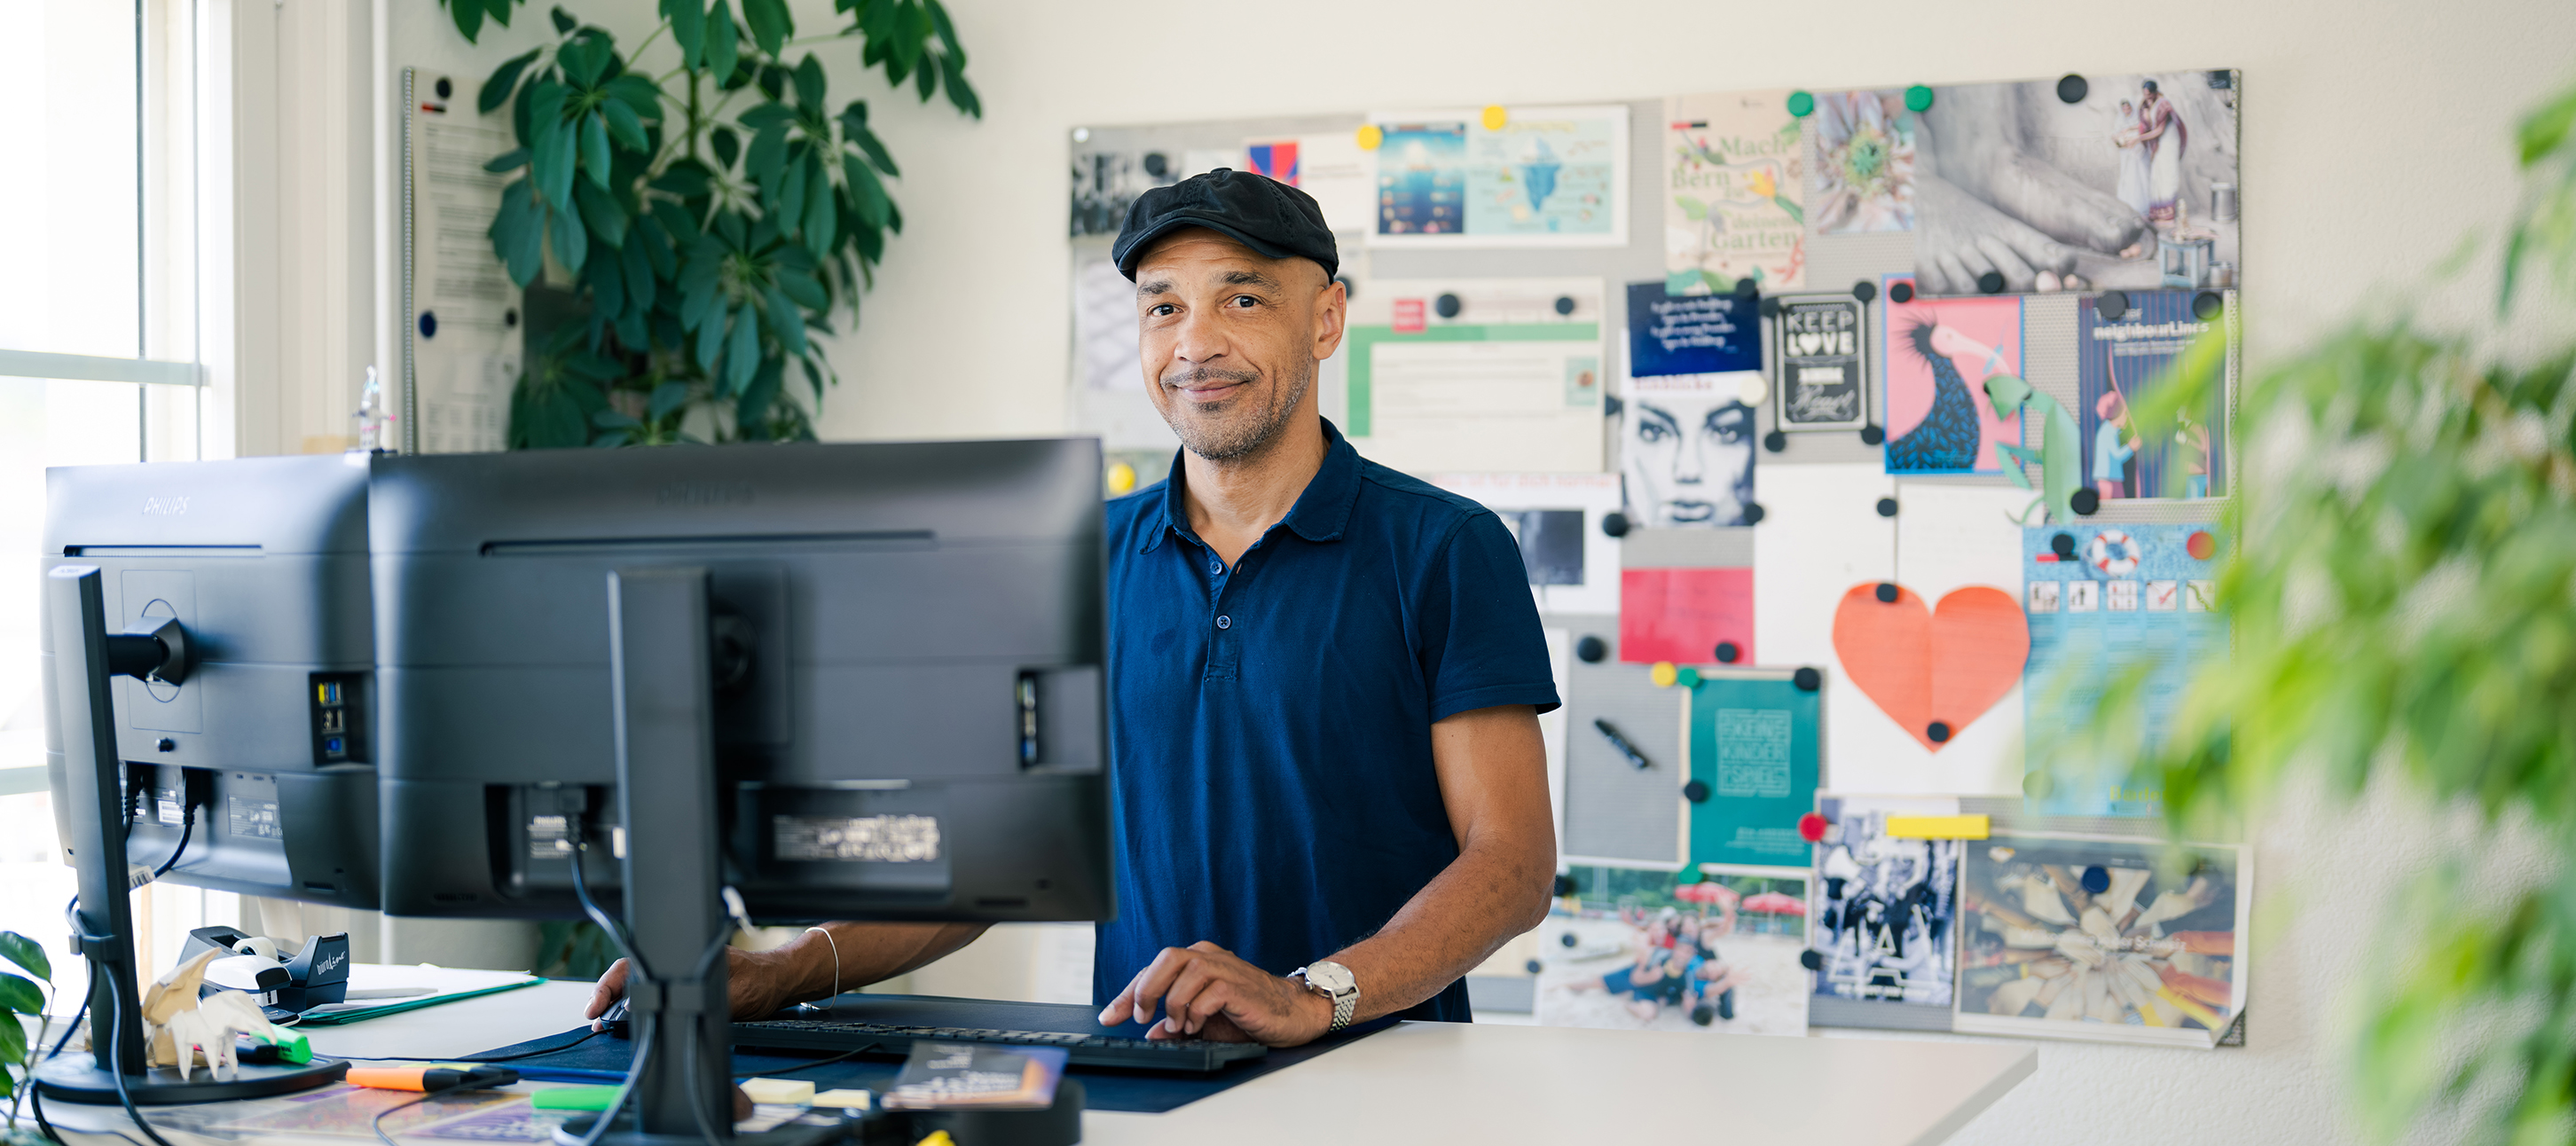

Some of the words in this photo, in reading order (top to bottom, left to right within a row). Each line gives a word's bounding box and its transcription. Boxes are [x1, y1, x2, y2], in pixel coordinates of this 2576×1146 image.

[1720, 132, 1787, 156] Mach
[1671, 168, 1731, 189] Bern
[1711, 230, 1798, 249] Garten
[1786, 310, 1855, 333] KEEP
[2093, 321, 2210, 341] neighbourLines
[142, 496, 190, 514] PHILIPS
